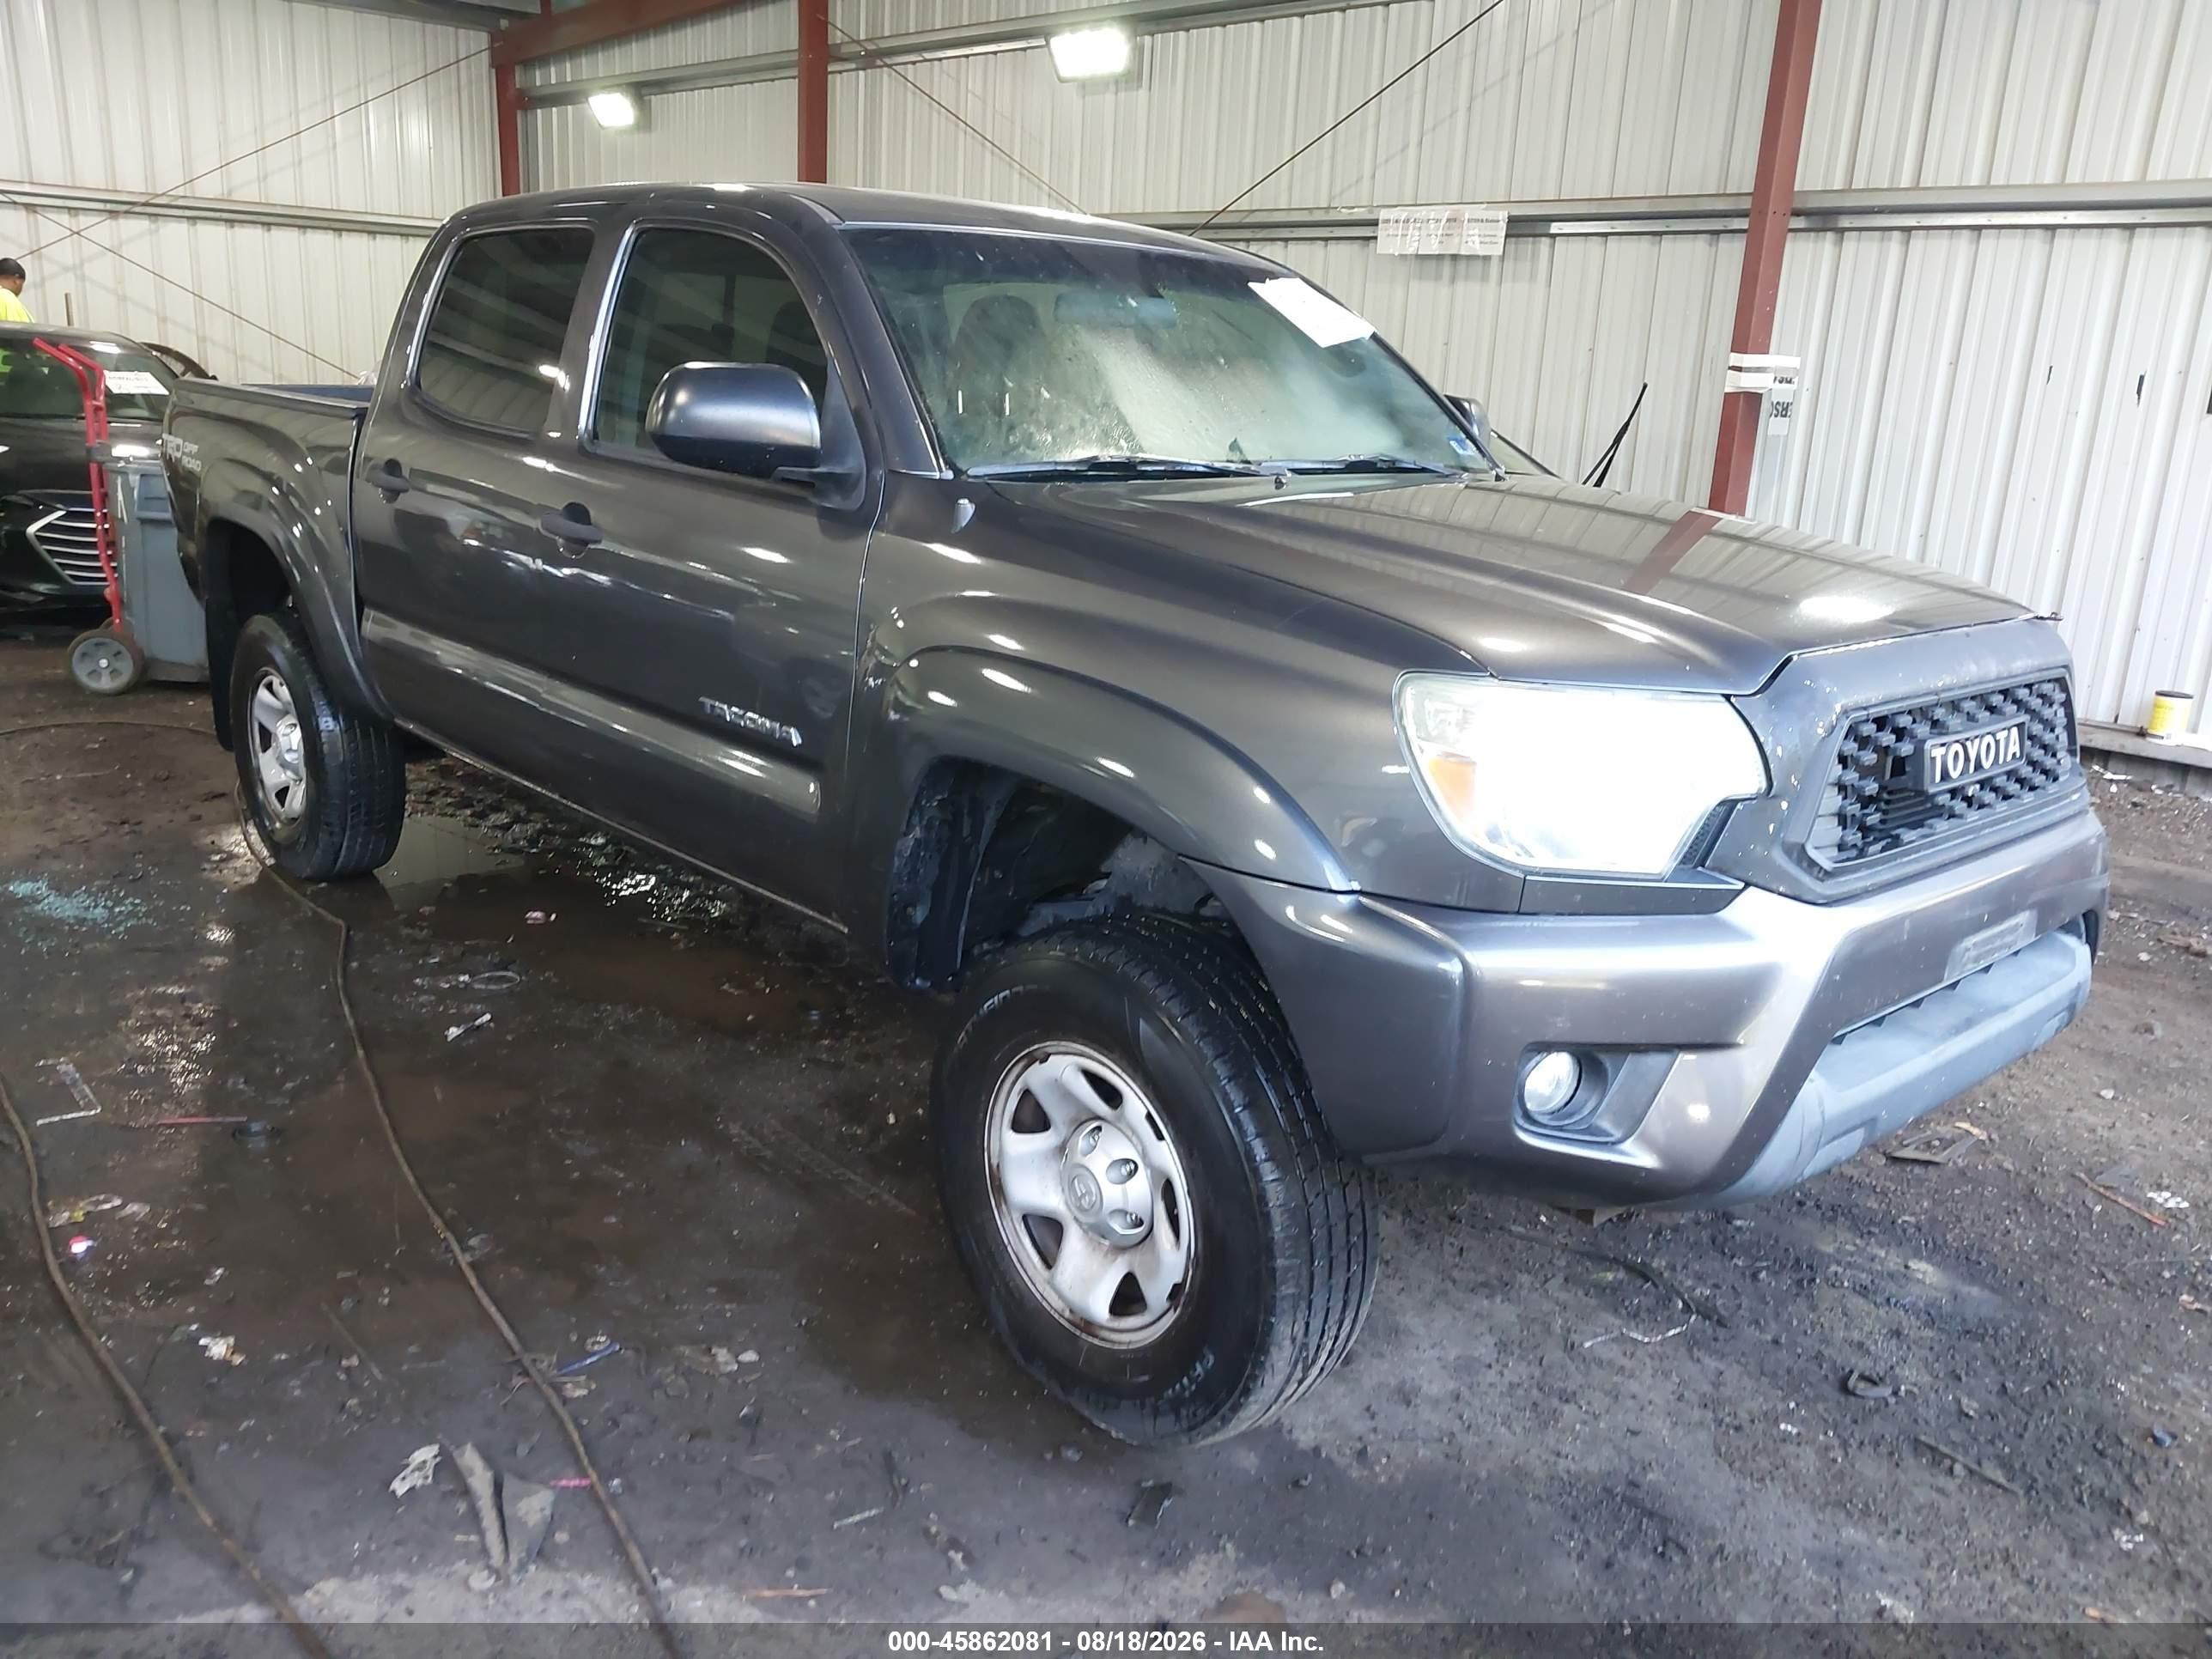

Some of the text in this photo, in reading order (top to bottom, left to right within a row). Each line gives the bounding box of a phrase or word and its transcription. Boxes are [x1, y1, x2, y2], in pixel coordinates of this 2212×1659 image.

[162, 433, 183, 463] TRD
[181, 455, 202, 471] ROAD
[698, 696, 803, 747] TACOMA
[1930, 726, 2021, 784] TOYOTA
